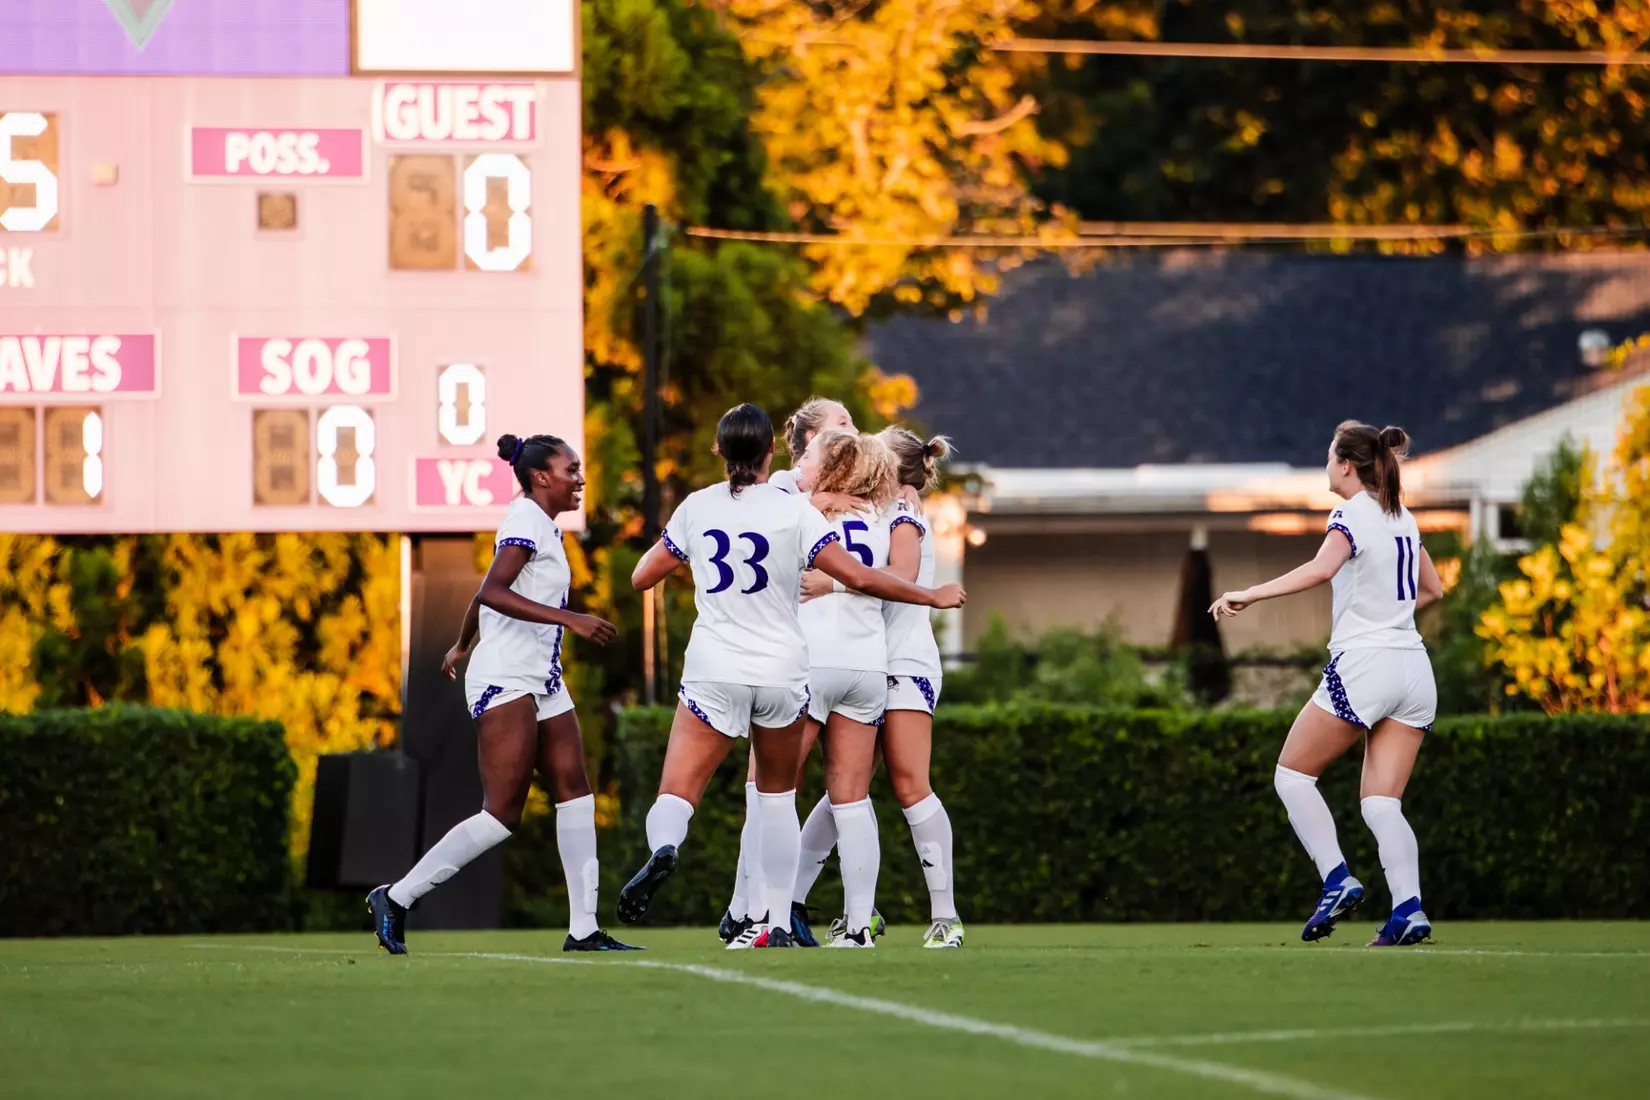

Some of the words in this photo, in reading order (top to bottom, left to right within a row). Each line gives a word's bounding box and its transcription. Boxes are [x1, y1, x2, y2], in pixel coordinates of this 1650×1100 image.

[385, 83, 536, 140] GUEST
[0, 112, 58, 231] 5
[224, 132, 330, 174] POSS.
[464, 153, 532, 271] 0
[260, 338, 371, 395] SOG
[438, 363, 486, 445] 0
[83, 411, 102, 498] 1
[317, 405, 375, 507] 0
[436, 459, 493, 506] YC
[703, 529, 770, 595] 33
[842, 520, 874, 568] 5
[1395, 536, 1416, 600] 11
